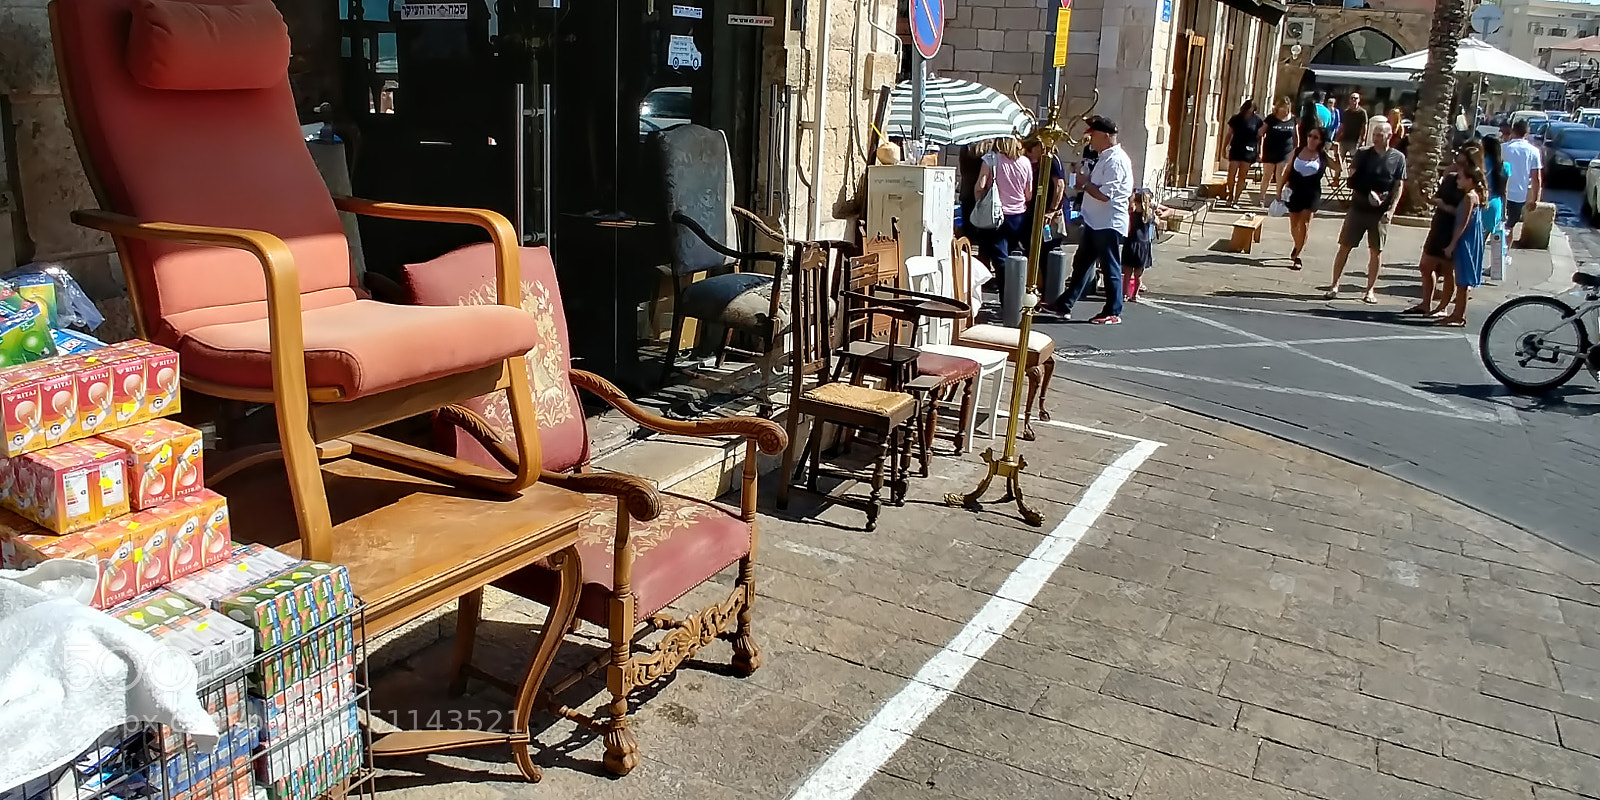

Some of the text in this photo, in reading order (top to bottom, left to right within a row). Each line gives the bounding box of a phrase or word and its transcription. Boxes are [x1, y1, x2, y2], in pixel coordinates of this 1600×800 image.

[402, 5, 466, 17] שמח זה העיקר
[159, 358, 177, 366] RITAJ
[125, 364, 144, 373] RITAJ
[90, 372, 109, 381] RITAJ
[53, 380, 73, 390] RITAJ
[16, 389, 37, 400] RITAJ
